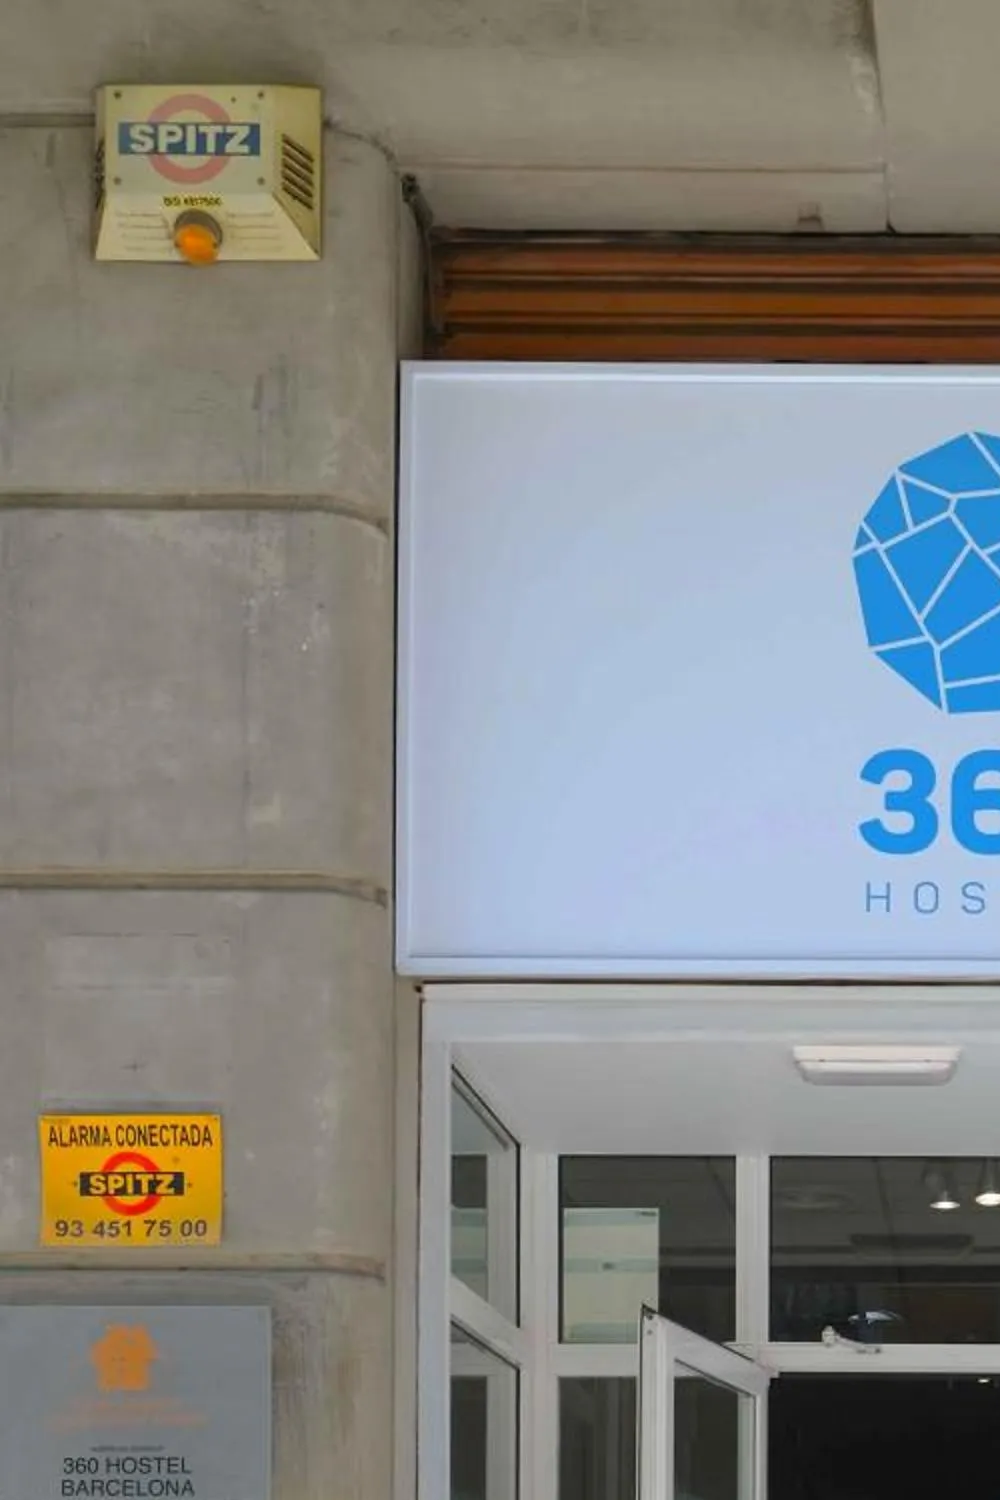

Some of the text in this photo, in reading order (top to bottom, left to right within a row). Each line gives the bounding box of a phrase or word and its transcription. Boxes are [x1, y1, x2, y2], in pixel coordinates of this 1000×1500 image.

[129, 124, 250, 153] SPITZ
[48, 1124, 213, 1147] ALARMA CONECTADA
[89, 1173, 175, 1195] SPITZ
[55, 1219, 208, 1237] 93 451 75 00
[63, 1456, 193, 1475] 360 HOSTEL
[61, 1479, 196, 1497] BARCELONA
